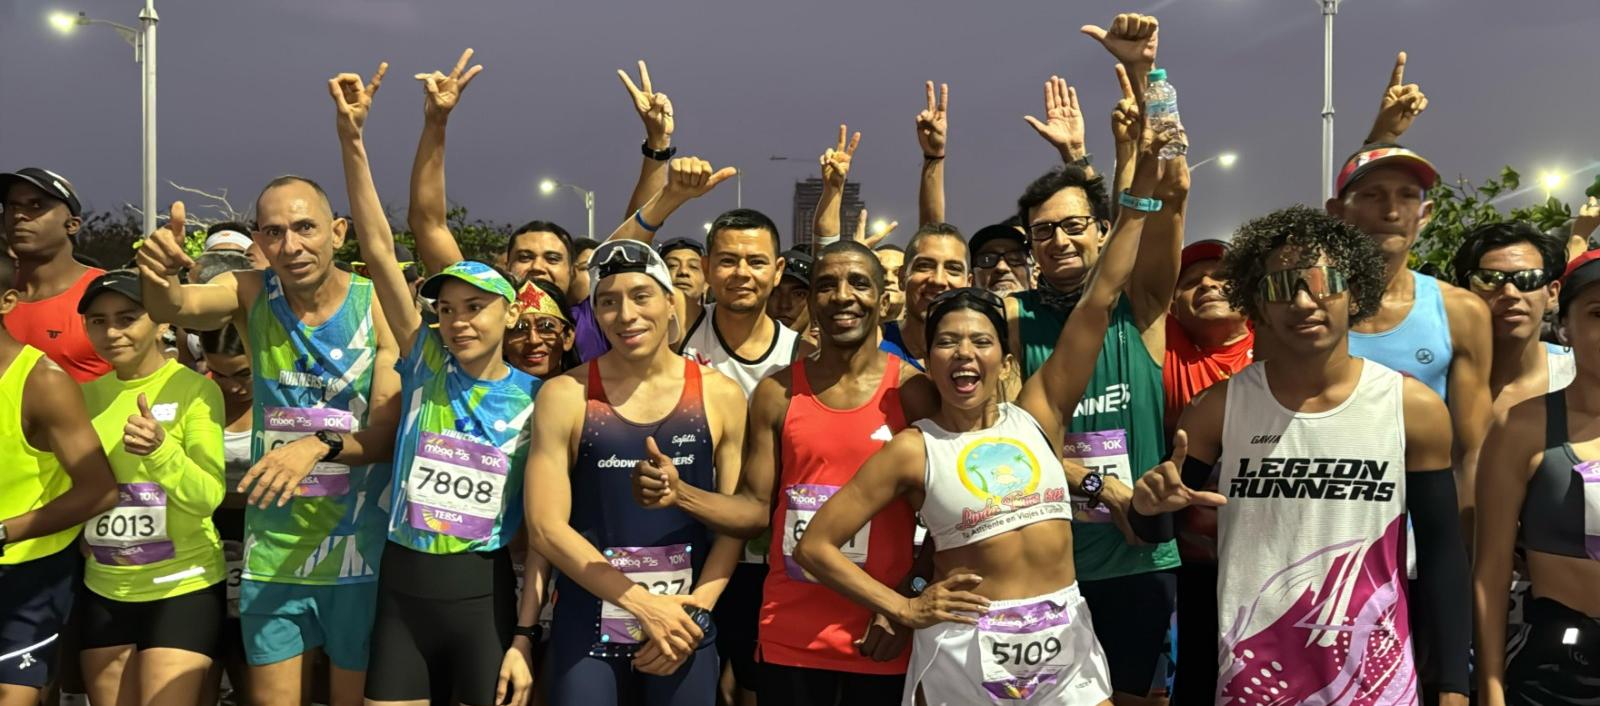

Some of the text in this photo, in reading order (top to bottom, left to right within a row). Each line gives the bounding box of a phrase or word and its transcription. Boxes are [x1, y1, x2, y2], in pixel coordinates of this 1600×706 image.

[323, 417, 345, 428] 10K
[1102, 440, 1122, 450] 10K
[480, 455, 501, 468] 10K
[1237, 458, 1390, 480] LEGION
[417, 466, 494, 504] 7808
[1228, 478, 1396, 502] RUNNERS
[96, 514, 155, 538] 6013
[434, 509, 464, 523] TEBSA
[992, 636, 1062, 666] 5109
